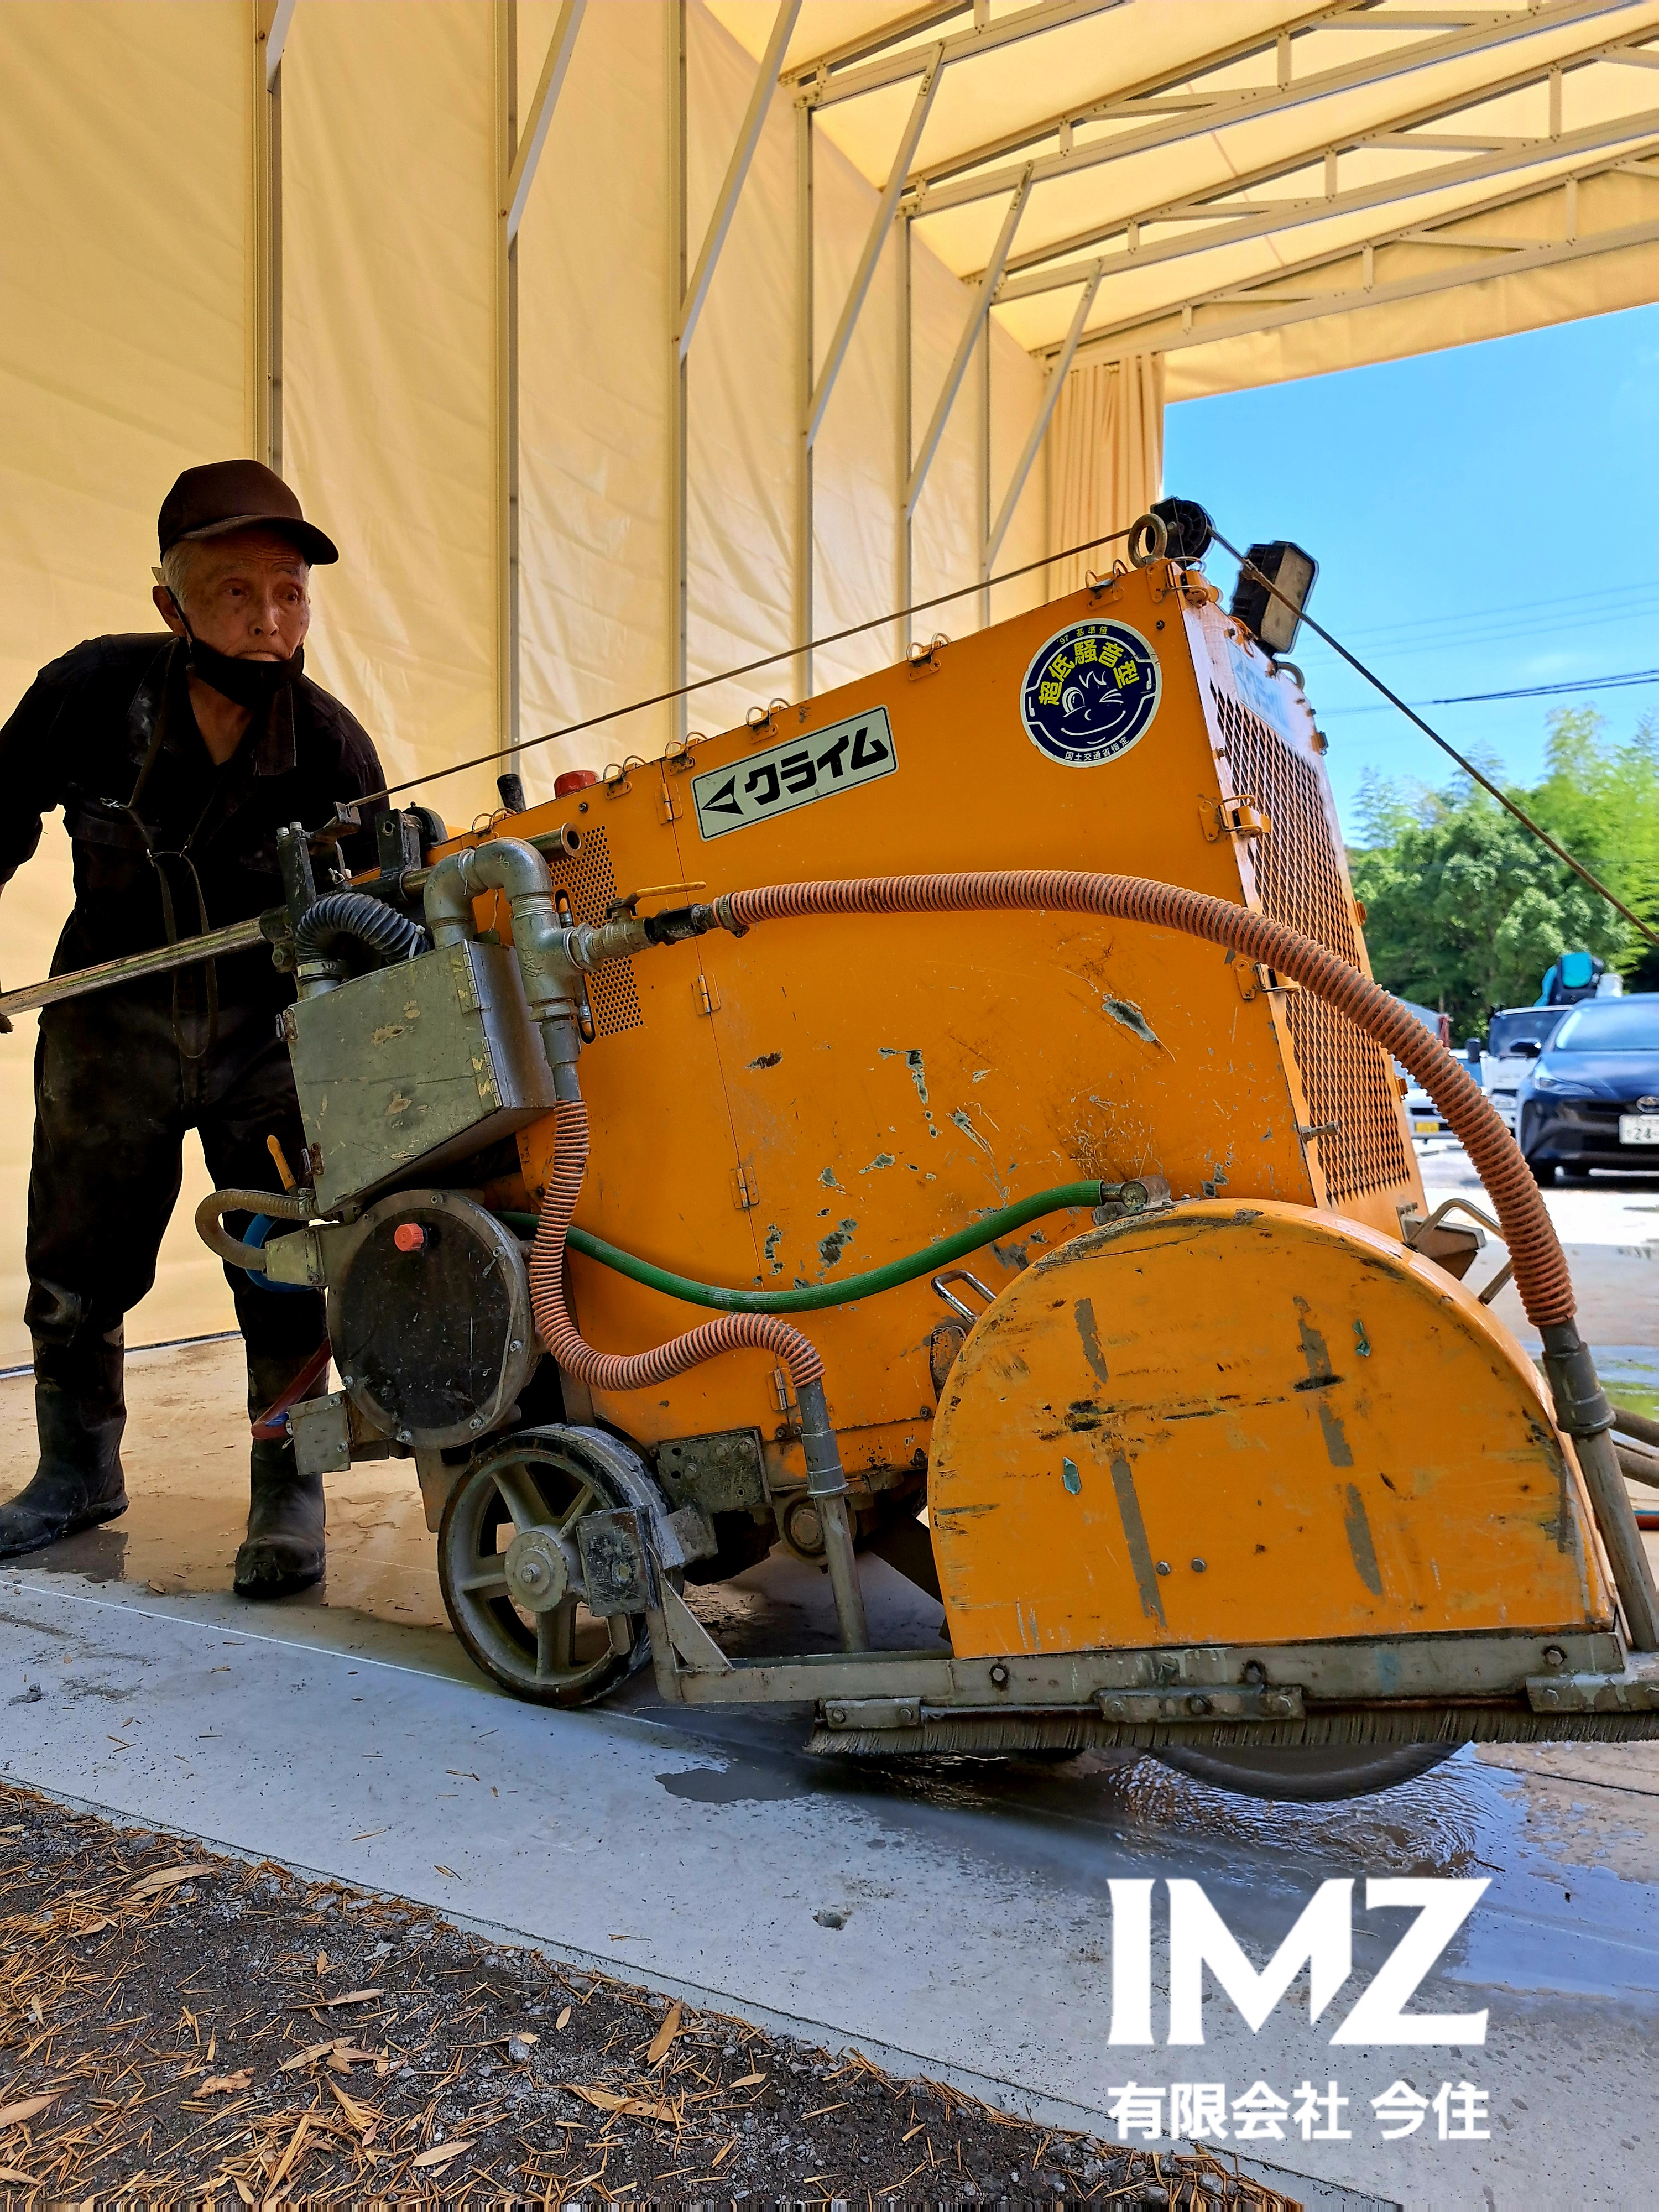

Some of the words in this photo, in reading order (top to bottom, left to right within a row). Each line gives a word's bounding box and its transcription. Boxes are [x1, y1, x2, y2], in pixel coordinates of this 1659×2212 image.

[1038, 638, 1140, 706] 超低騒音型
[744, 726, 889, 806] クライム
[1065, 736, 1129, 761] 国土交通省指定
